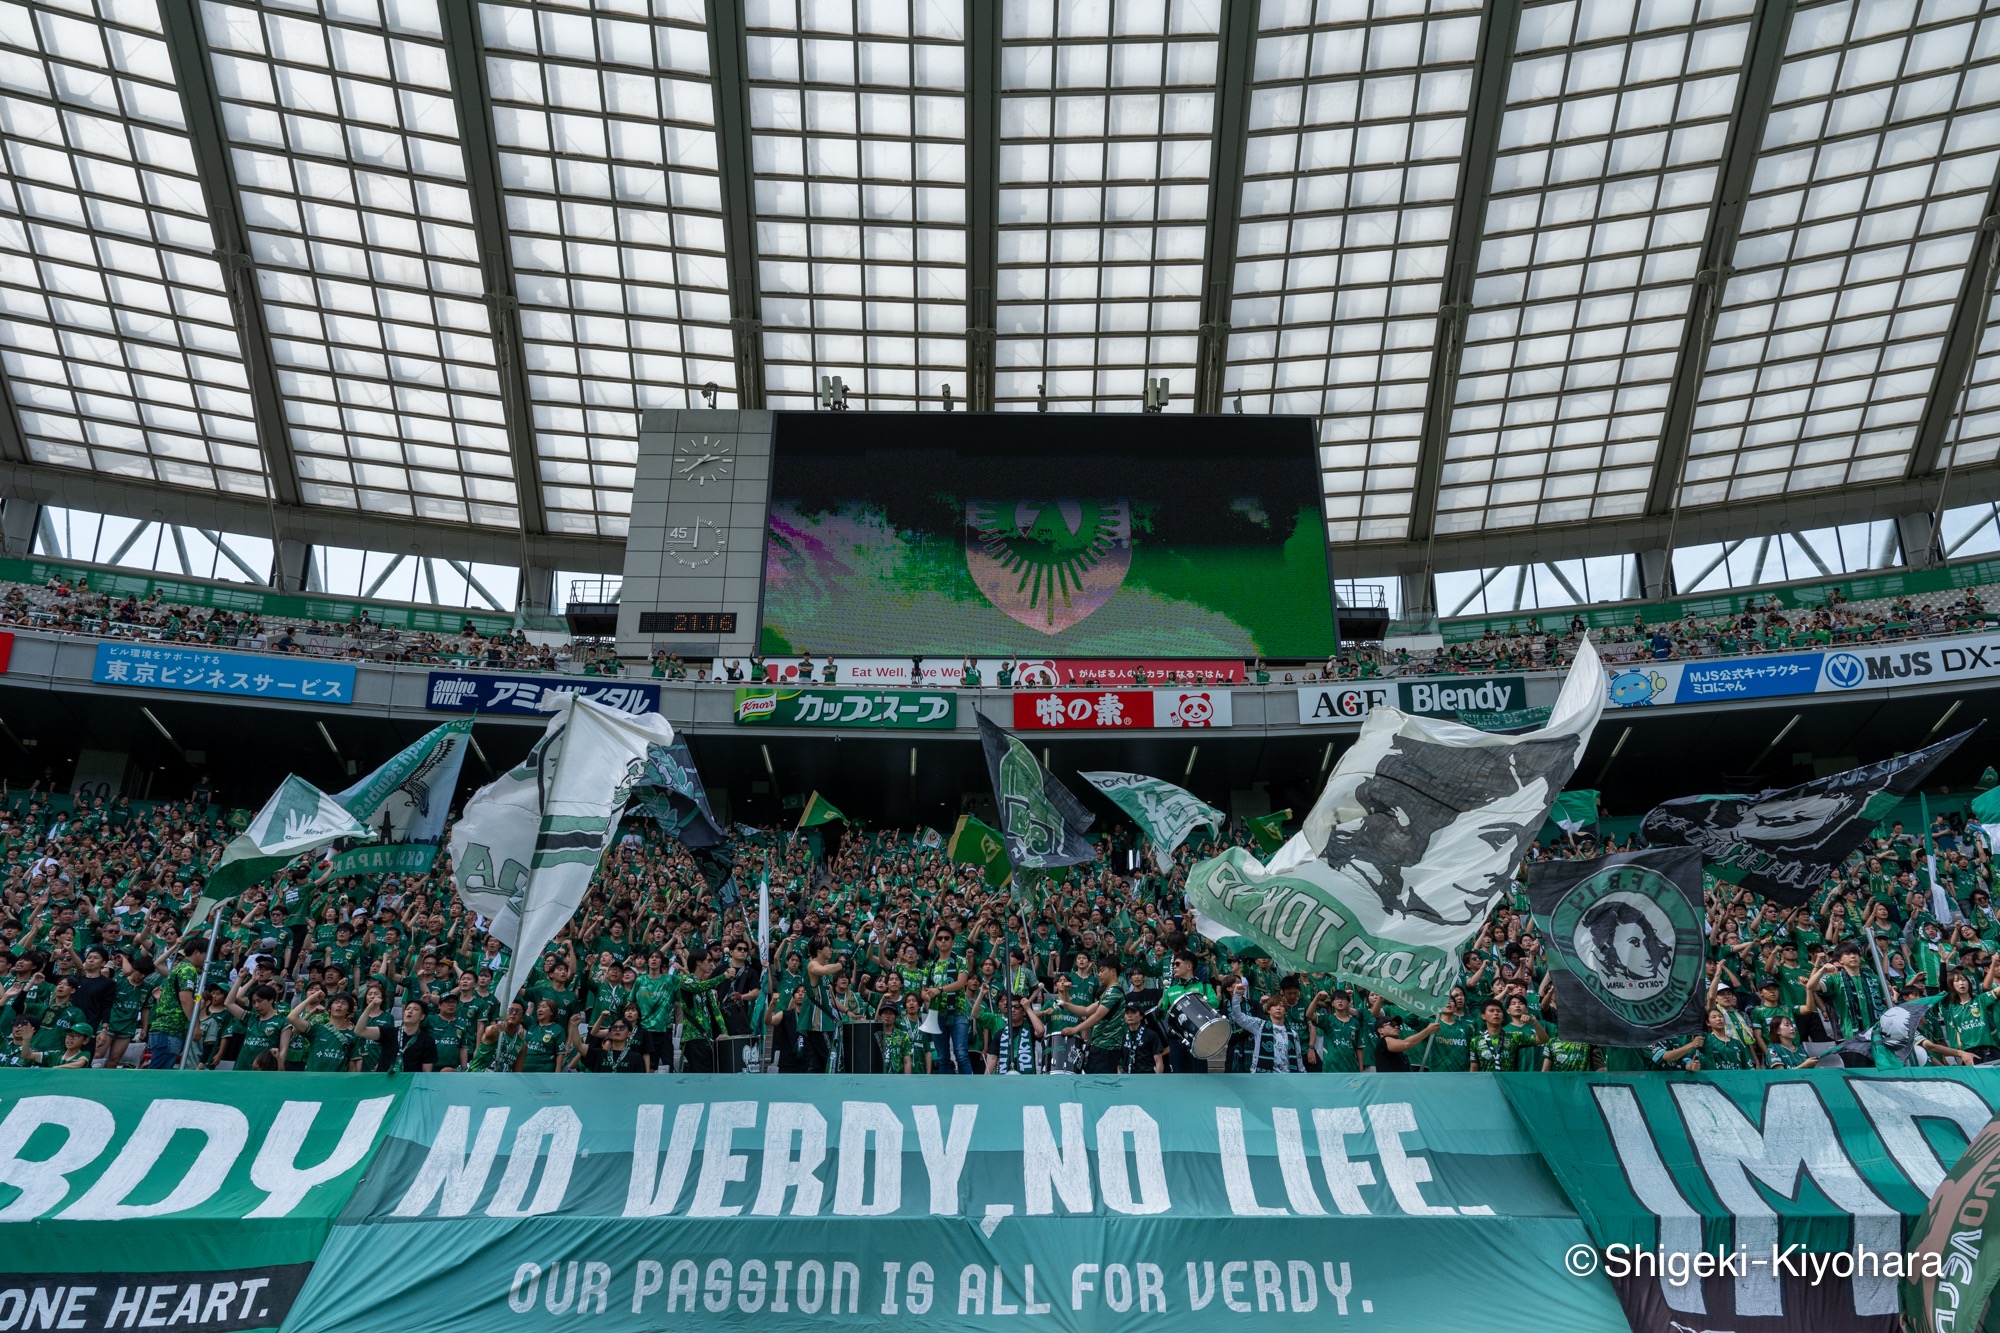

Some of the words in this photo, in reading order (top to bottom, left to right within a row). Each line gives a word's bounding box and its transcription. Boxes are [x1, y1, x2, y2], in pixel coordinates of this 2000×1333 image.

[670, 527, 687, 539] 45
[109, 646, 220, 666] ビル環境をサポートする
[1865, 650, 1933, 681] MJS
[104, 659, 342, 698] 東京ビジネスサービス
[851, 667, 872, 677] Eat
[876, 667, 907, 679] Well,
[1689, 664, 1811, 683] MJS公式キャラクター
[433, 677, 477, 694] amino
[1692, 681, 1747, 695] ミロにゃん
[431, 691, 463, 706] VITAL
[742, 698, 775, 712] Knorr
[1312, 688, 1387, 718] AGF
[1411, 681, 1511, 712] Blendy
[794, 694, 950, 723] カップスープ
[1092, 773, 1148, 789] TOKYO
[389, 1105, 583, 1218] NO
[1022, 1102, 1172, 1215] NO
[1216, 1102, 1497, 1216] LIFE.
[508, 1261, 611, 1315] OUR
[631, 1258, 860, 1314] PASSION
[882, 1261, 934, 1315] IS
[957, 1263, 1051, 1315] ALL
[1071, 1262, 1167, 1313] FOR
[1186, 1259, 1373, 1316] VERDY.
[0, 1286, 97, 1331] ONE
[104, 1278, 269, 1328] HEART.
